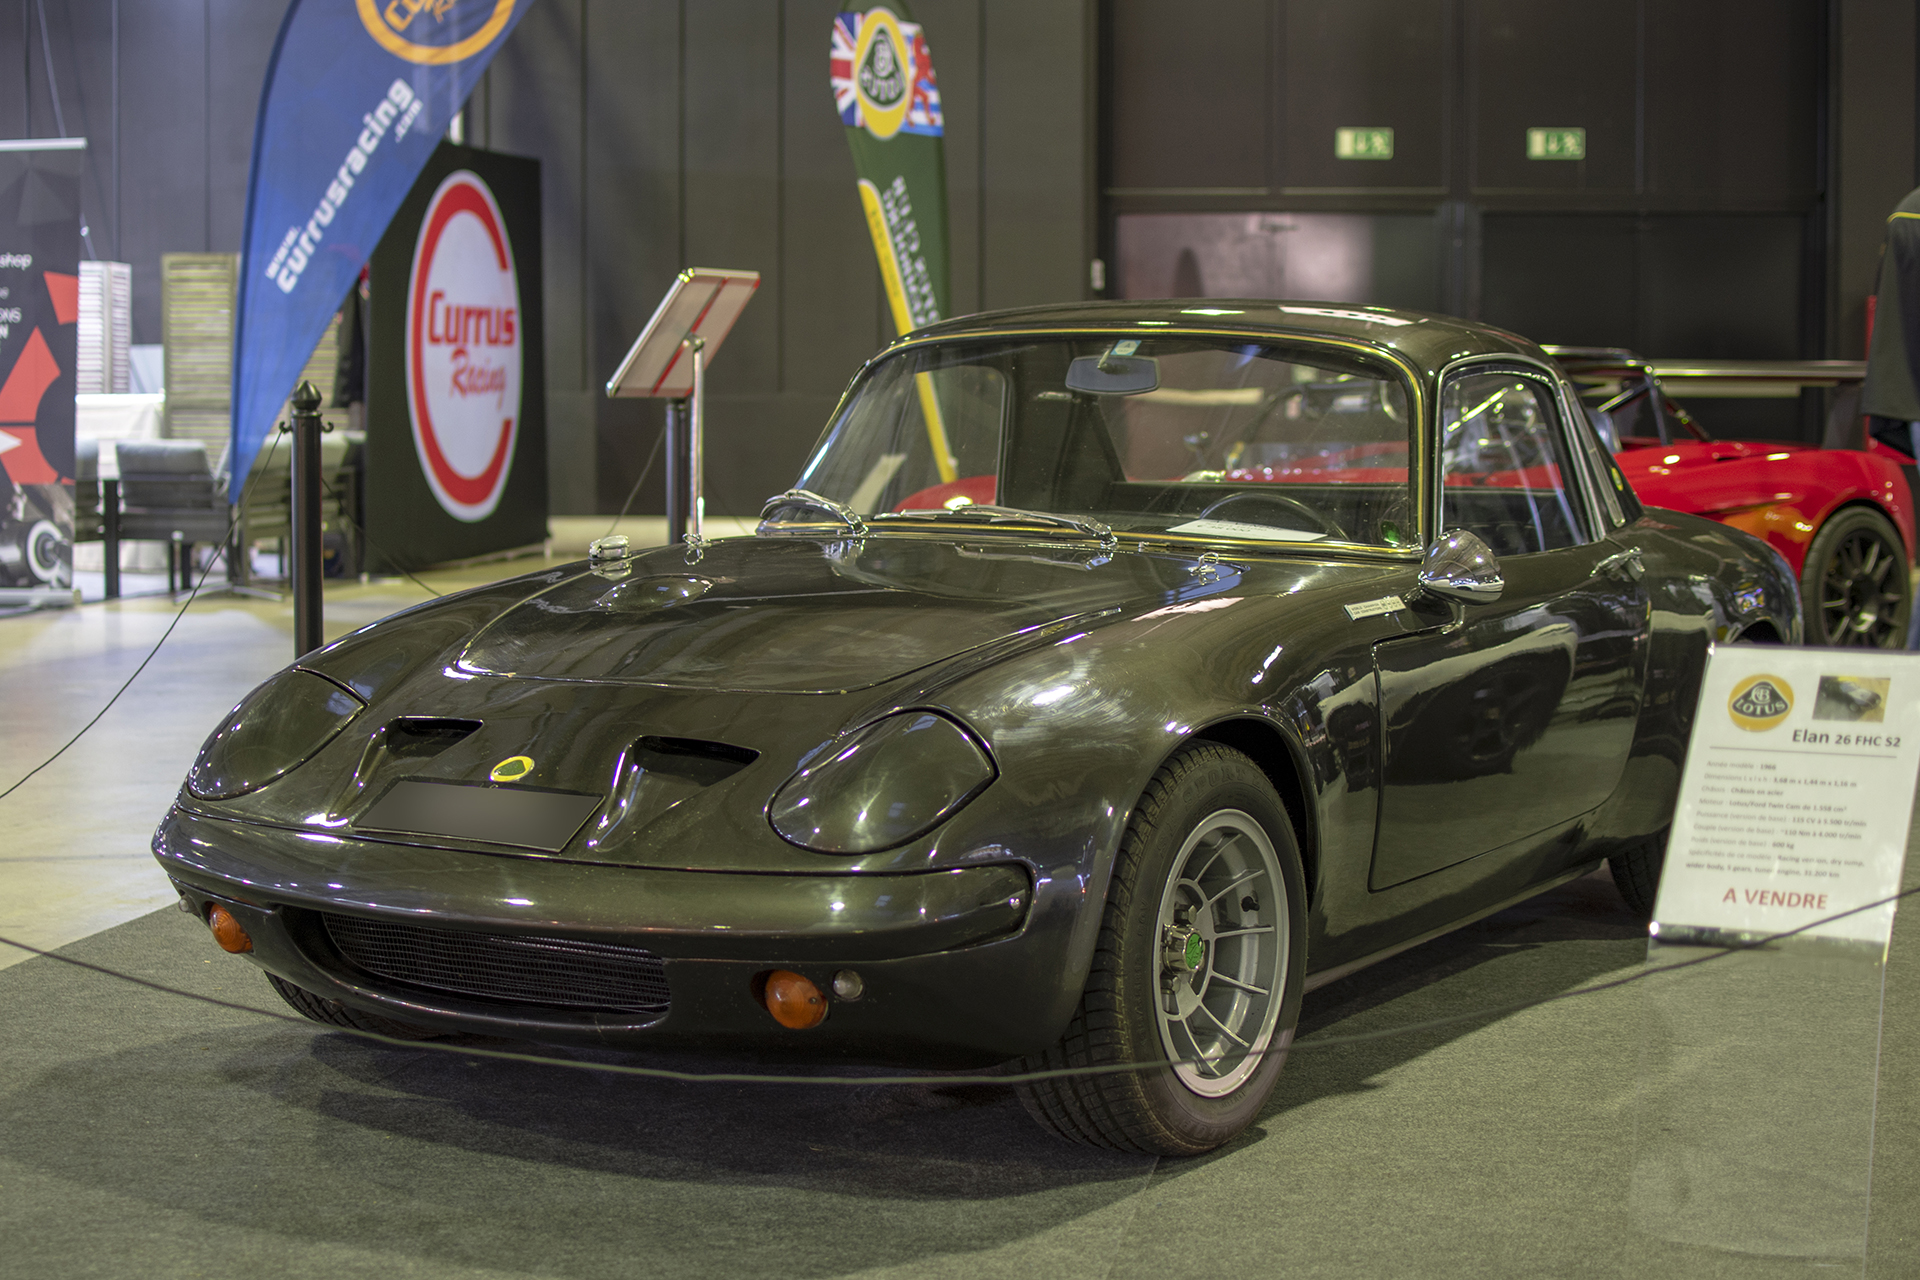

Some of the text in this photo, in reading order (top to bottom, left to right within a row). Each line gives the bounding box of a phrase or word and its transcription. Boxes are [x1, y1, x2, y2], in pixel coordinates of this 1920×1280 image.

[276, 78, 414, 294] currusracing
[428, 290, 516, 345] Currus
[449, 347, 506, 411] Racing
[1735, 699, 1786, 715] LOTUS
[1792, 729, 1901, 748] Elan 26 FHC S2
[1722, 887, 1828, 910] A VENDRE
